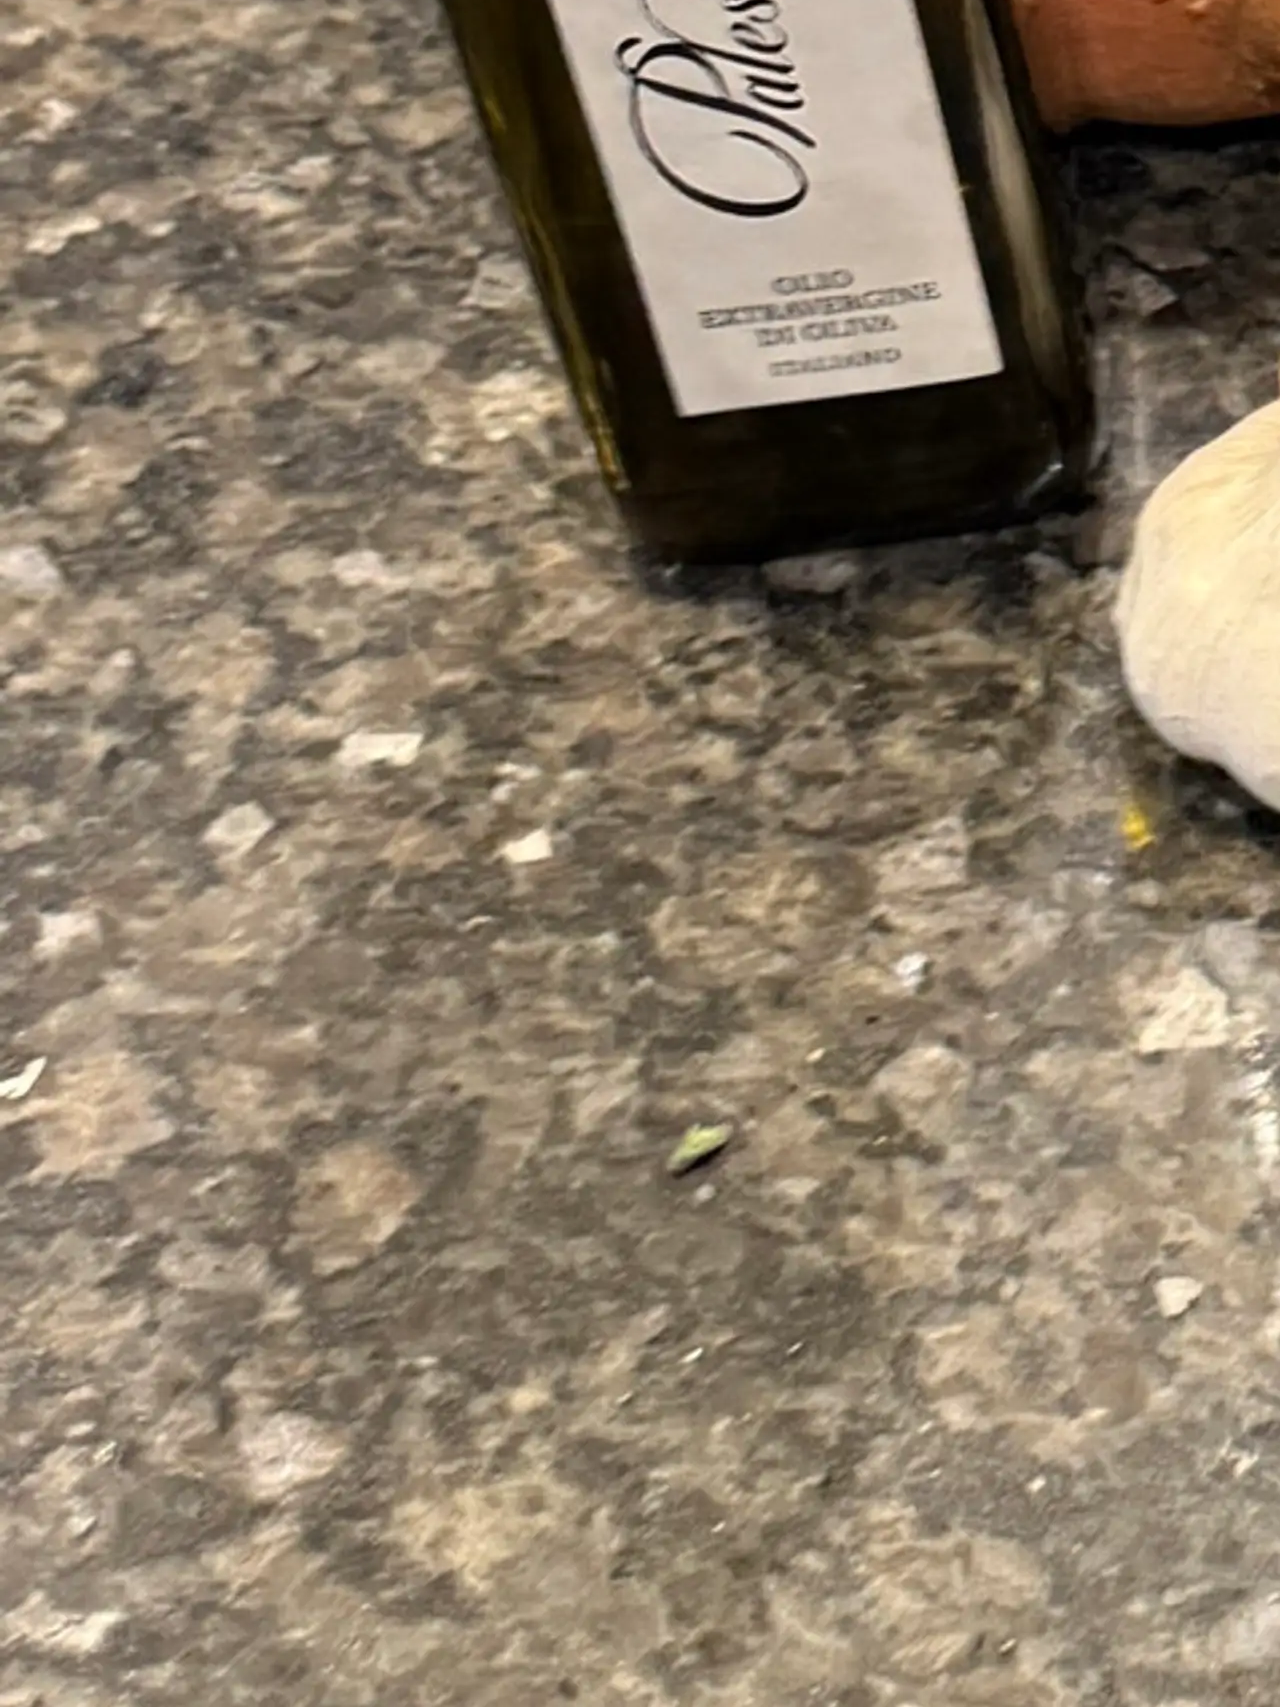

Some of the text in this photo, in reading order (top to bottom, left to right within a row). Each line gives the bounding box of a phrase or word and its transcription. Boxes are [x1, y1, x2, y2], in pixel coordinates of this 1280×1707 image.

[770, 268, 855, 296] OLIO
[697, 281, 942, 330] EXTRAVERGINE
[754, 314, 900, 349] DI OLIVA
[768, 346, 903, 378] ITALIANO
